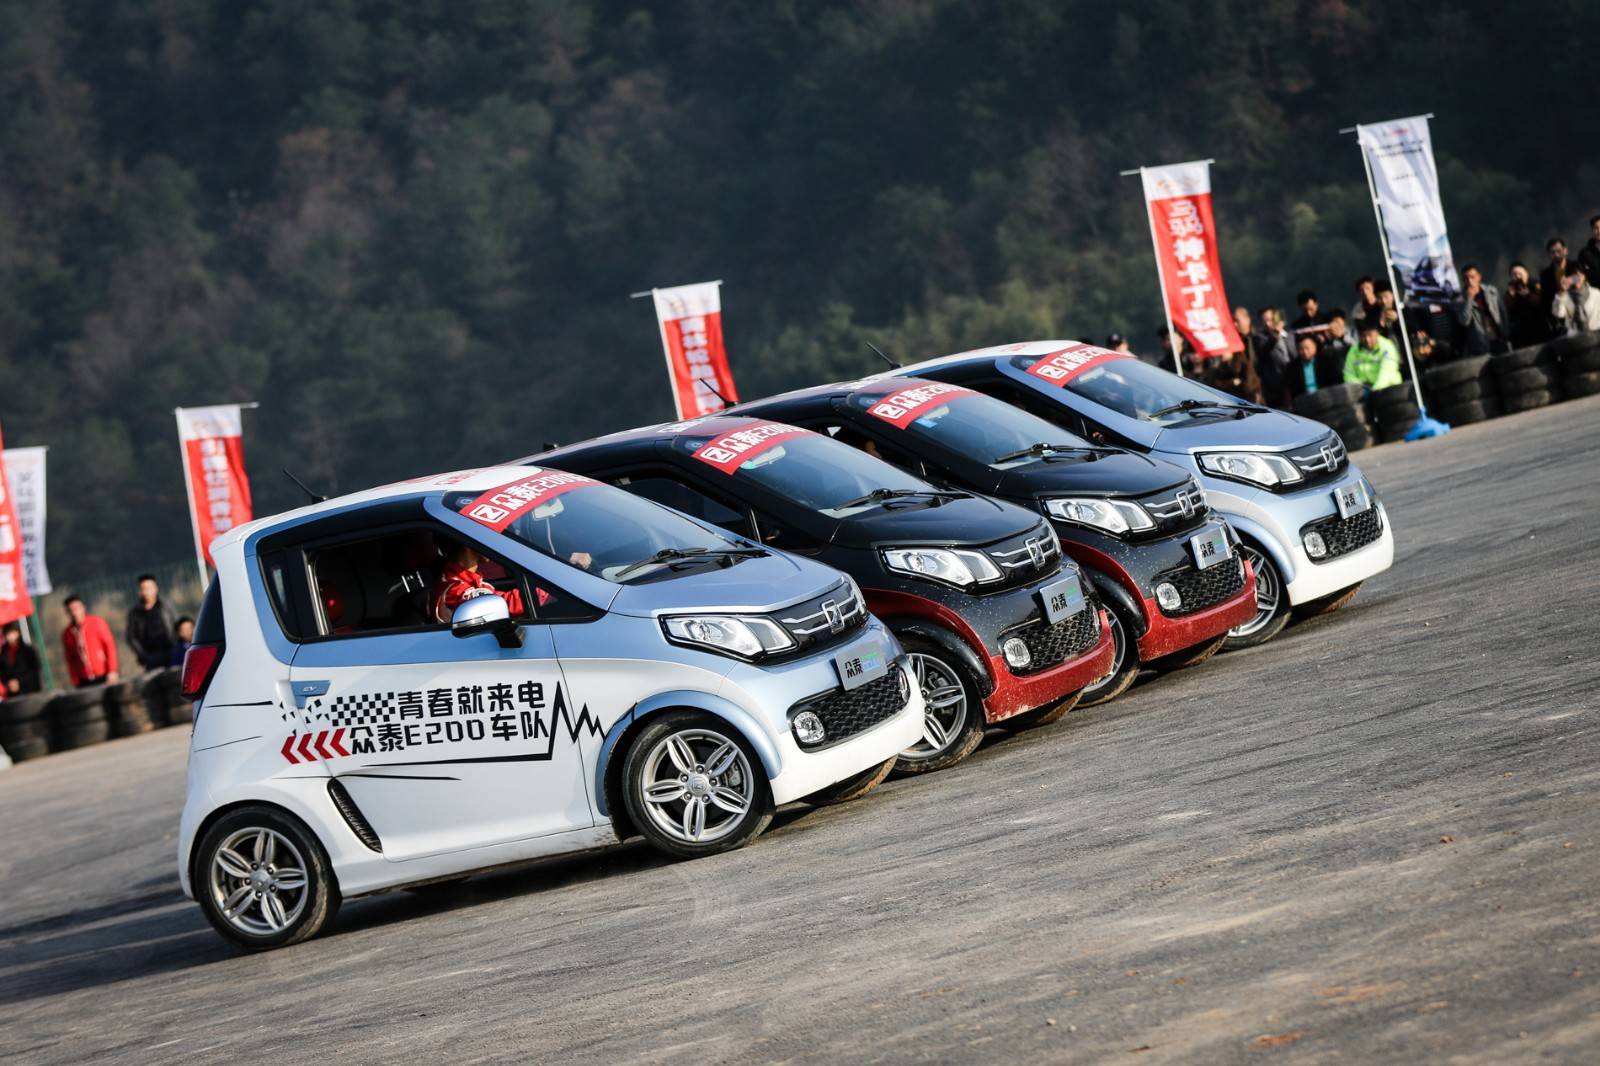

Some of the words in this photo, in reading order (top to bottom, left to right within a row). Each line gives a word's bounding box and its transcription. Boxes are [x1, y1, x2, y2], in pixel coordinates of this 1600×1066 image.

[1051, 592, 1068, 613] 众泰
[844, 657, 863, 679] 众泰
[396, 680, 546, 721] 青春就来电
